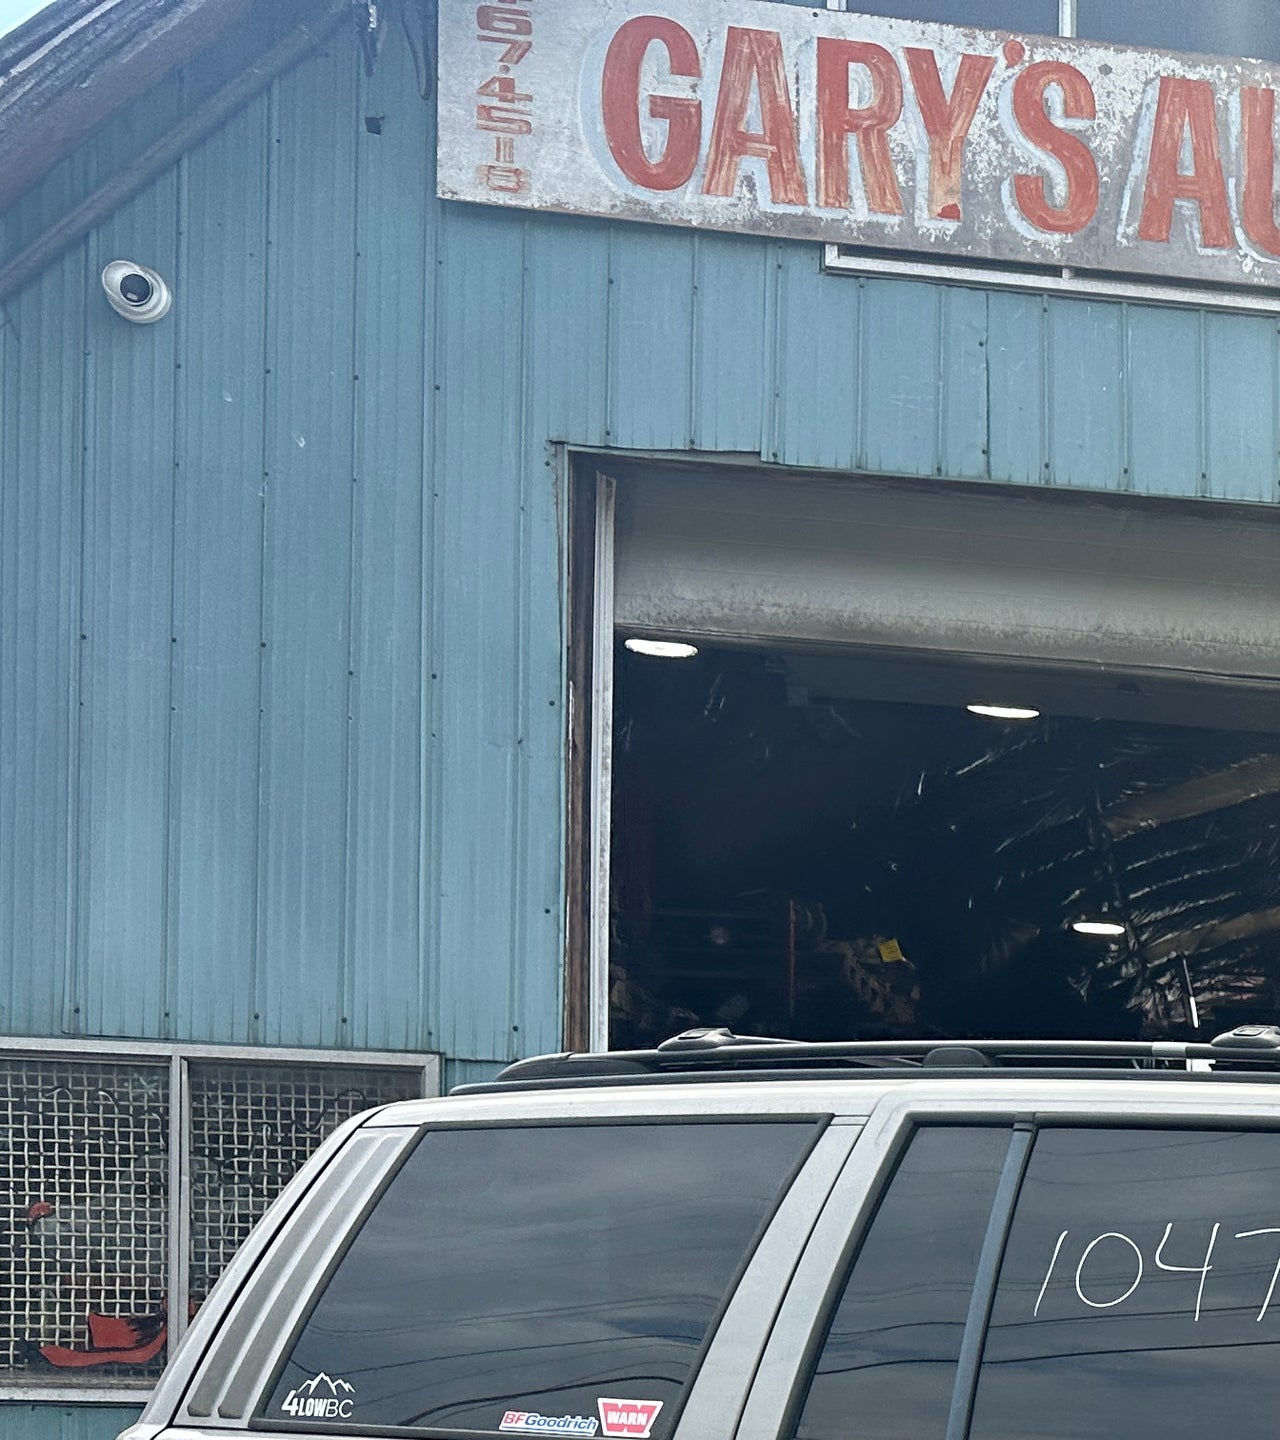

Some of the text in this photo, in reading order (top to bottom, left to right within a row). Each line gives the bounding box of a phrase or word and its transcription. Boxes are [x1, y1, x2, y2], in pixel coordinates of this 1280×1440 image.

[600, 14, 1098, 236] GARY'S
[503, 1413, 598, 1431] BFGoodrich
[607, 1411, 648, 1426] WARN
